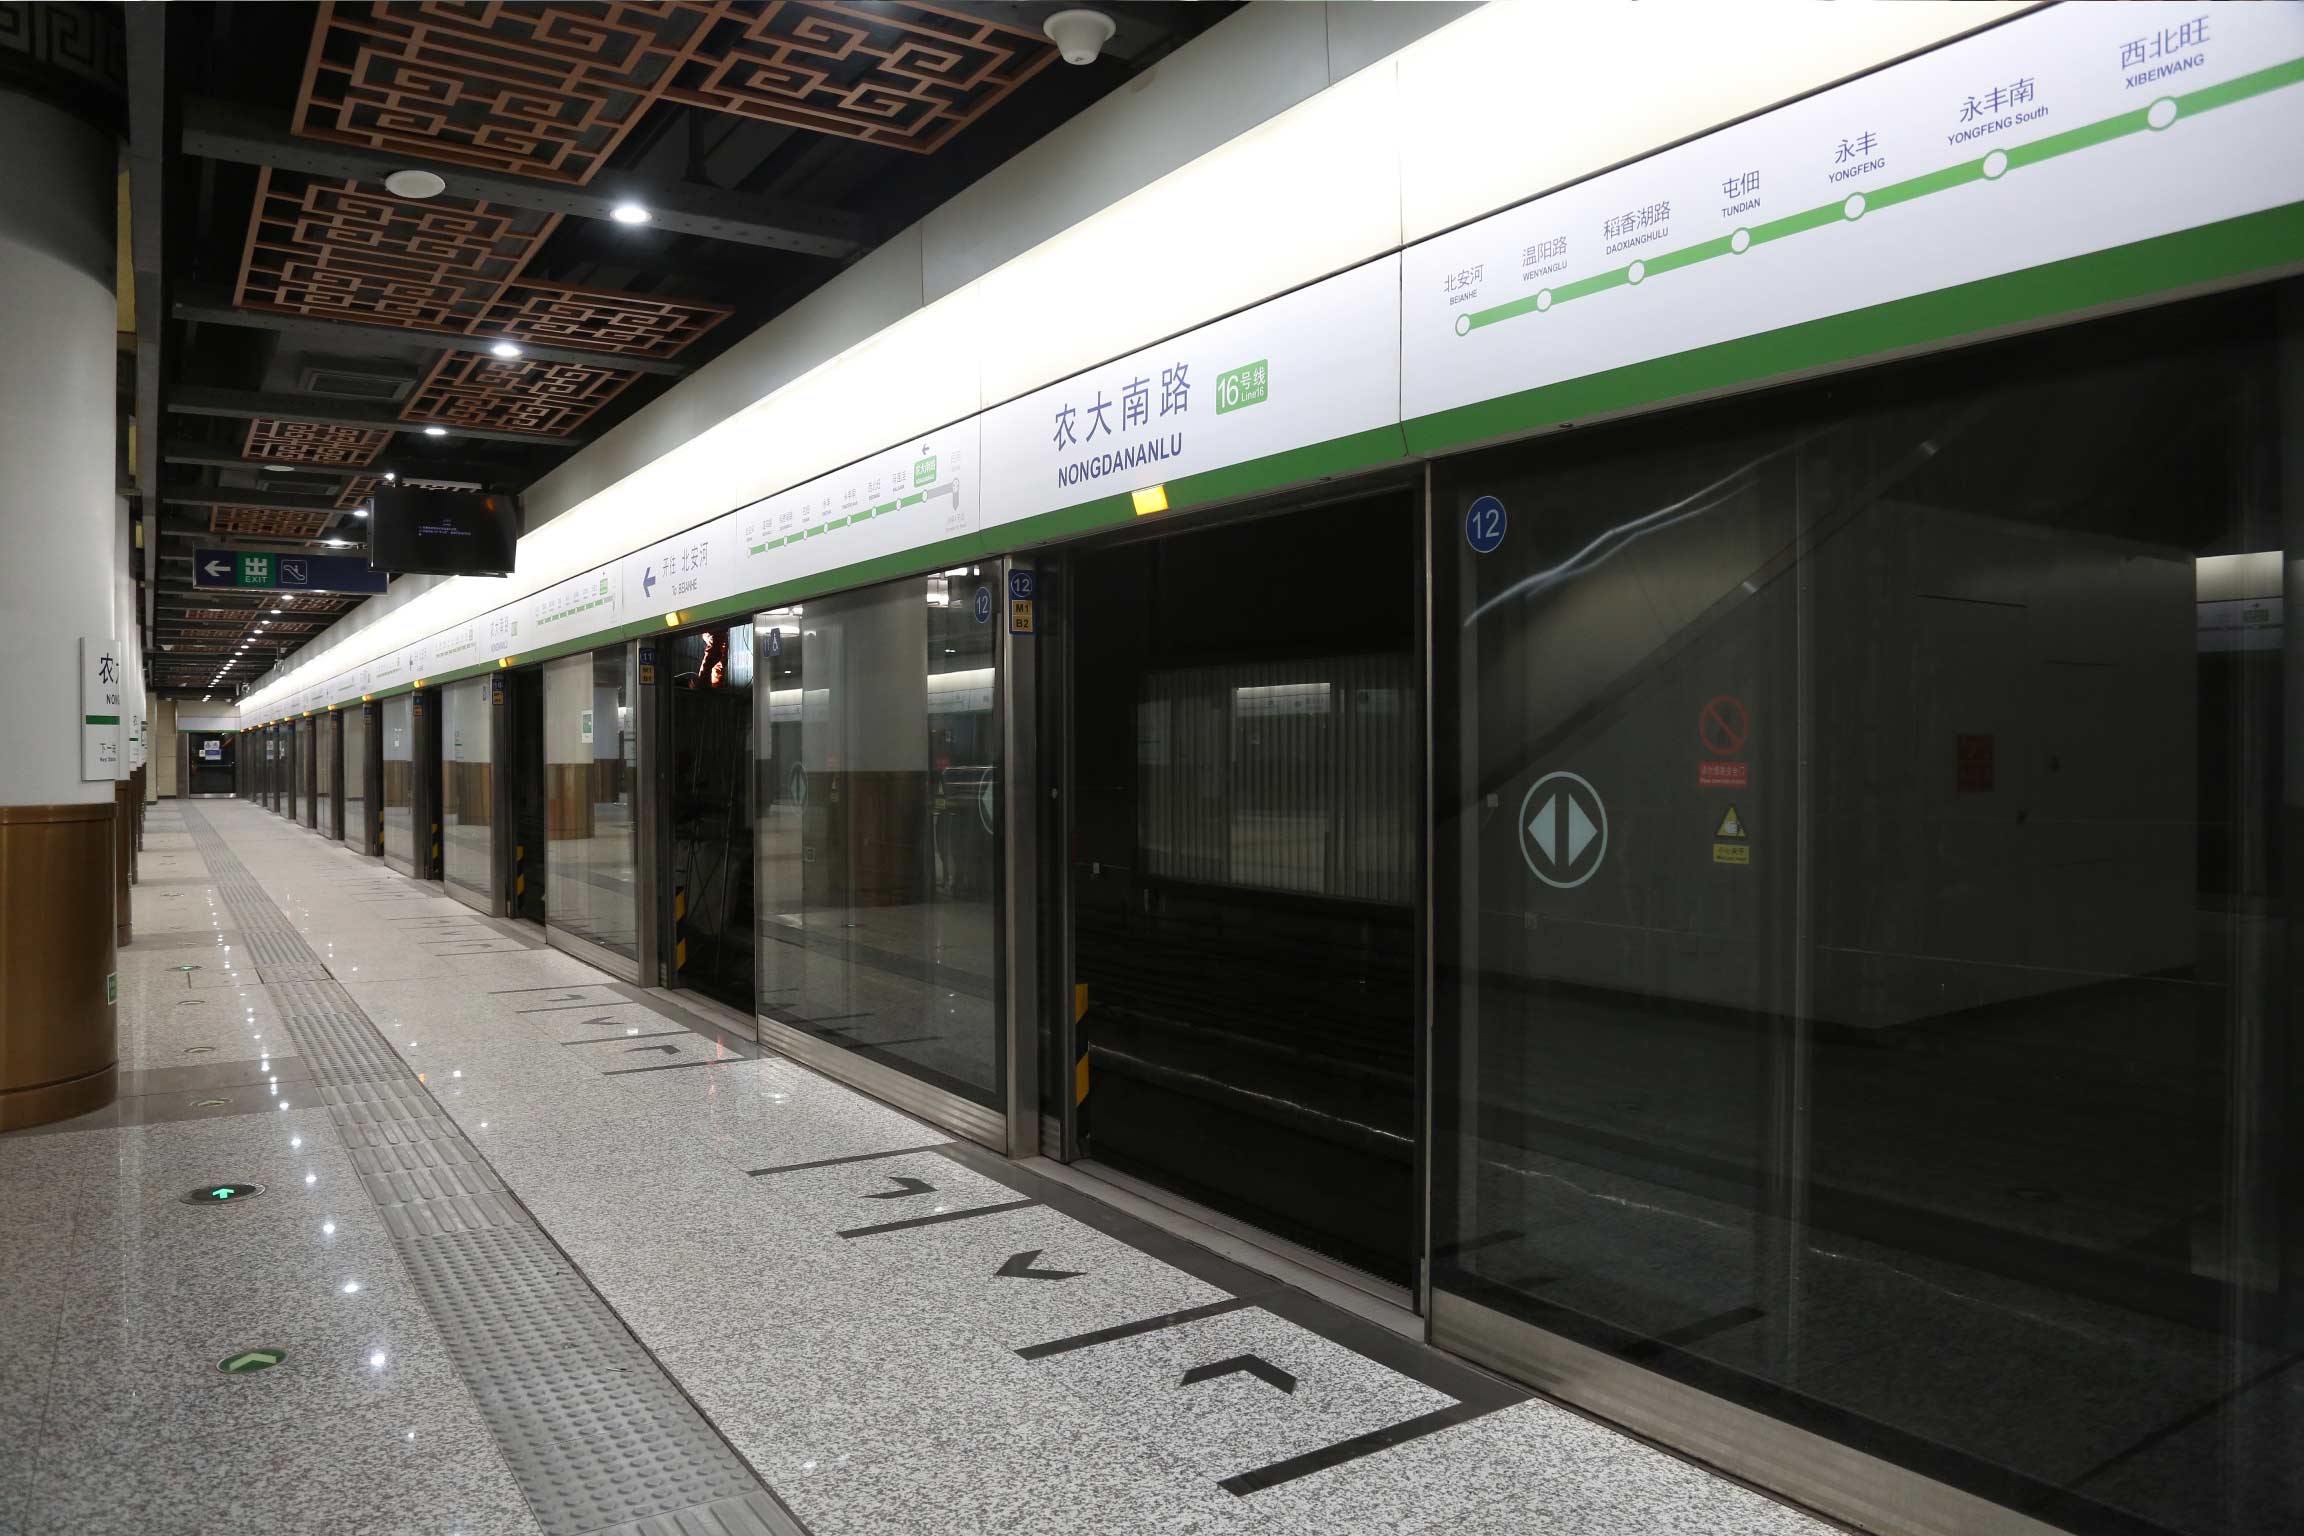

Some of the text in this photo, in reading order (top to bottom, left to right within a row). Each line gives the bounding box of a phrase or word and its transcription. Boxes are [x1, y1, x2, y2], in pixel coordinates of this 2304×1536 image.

[2120, 15, 2211, 70] 西北旺
[2125, 53, 2205, 90] XIBEIWANG
[1959, 76, 2035, 123] 永丰南
[1948, 105, 2050, 146] YONGFENG South
[1834, 131, 1879, 164] 永丰
[1721, 170, 1760, 199] 屯佃
[1828, 157, 1886, 184] YONGFENG
[1603, 200, 1671, 241] 稻香湖路
[1721, 198, 1761, 218] TUNDIAN
[1521, 235, 1568, 268] 温阳路
[1606, 227, 1669, 255] DAOXIANGHULU
[1444, 264, 1485, 293] 北安河
[1522, 260, 1568, 282] WENYANGLU
[1449, 289, 1478, 306] BEIANHE
[1053, 361, 1191, 452] 农大南路
[1058, 432, 1183, 489] NONGDANANLU
[1472, 508, 1500, 540] 12
[245, 575, 268, 583] EXIT
[1013, 577, 1030, 592] 12
[976, 595, 989, 615] 12
[1015, 603, 1029, 613] M1
[1016, 619, 1029, 628] B2
